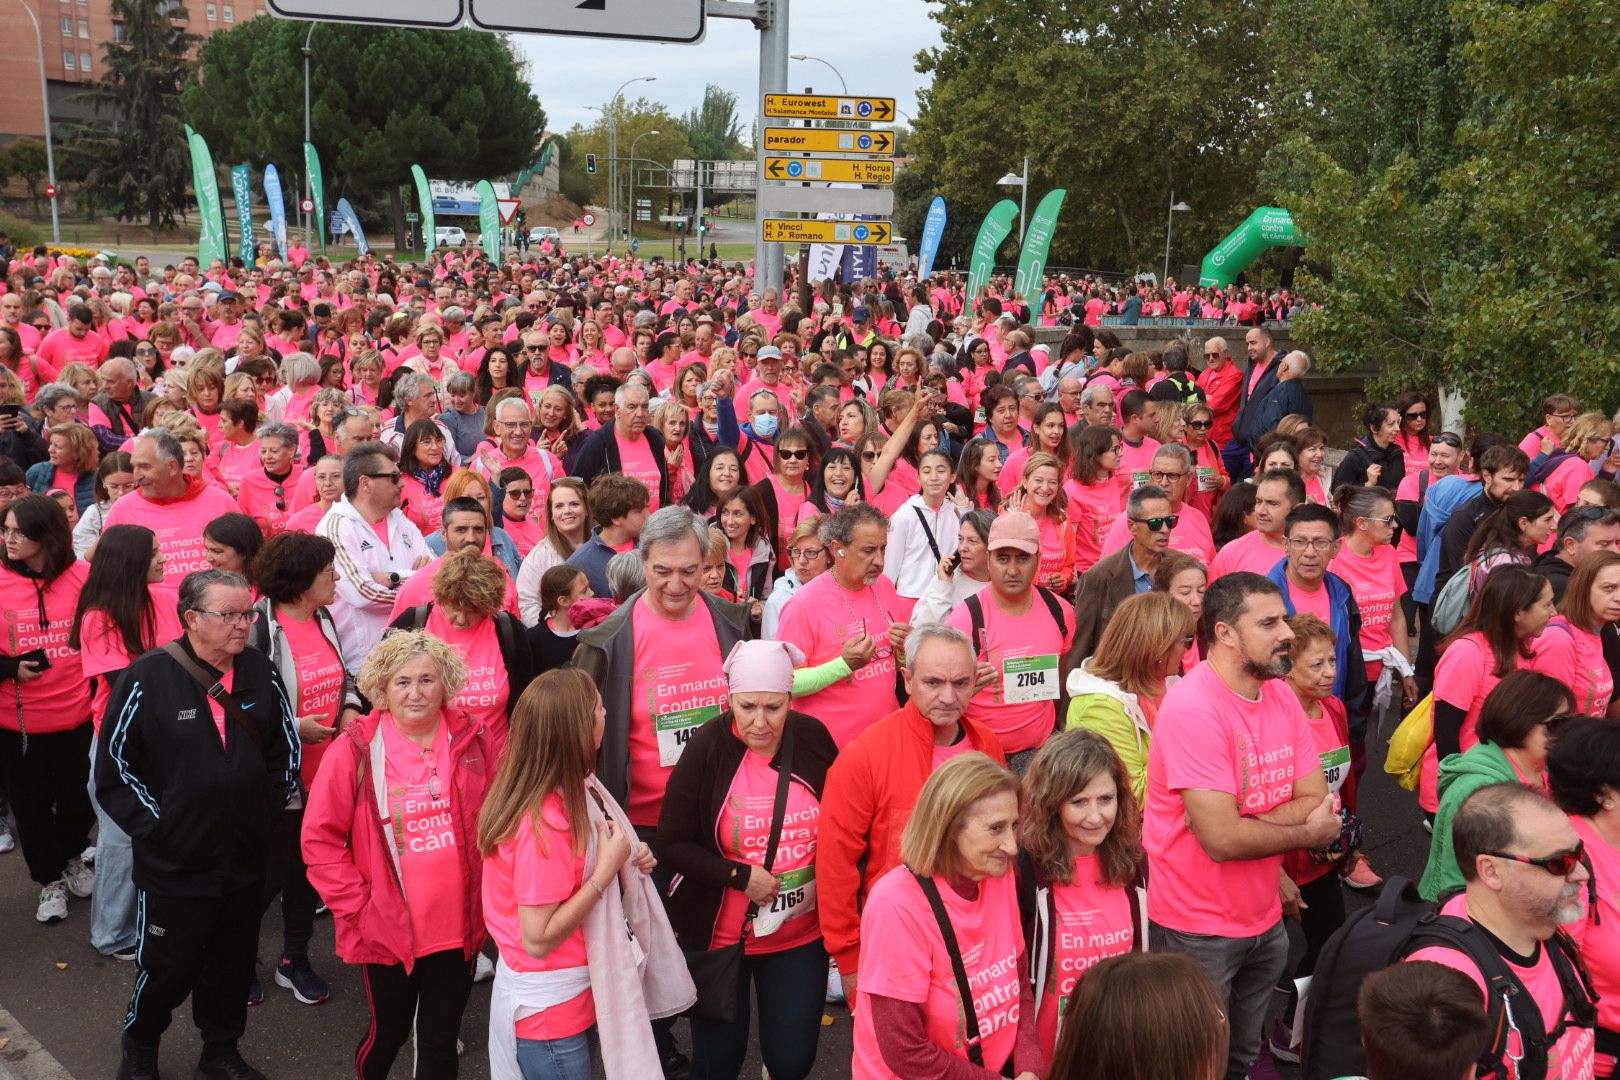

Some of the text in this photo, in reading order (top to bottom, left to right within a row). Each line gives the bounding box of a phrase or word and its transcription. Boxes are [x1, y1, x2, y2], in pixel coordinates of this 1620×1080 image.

[767, 98, 826, 108] H. Eurowest
[767, 135, 806, 145] parador
[852, 163, 891, 172] H. Horus
[854, 172, 891, 182] H. Regio
[778, 223, 803, 231] Vincci
[1261, 224, 1284, 232] contra
[765, 231, 824, 240] H. P. Romano
[163, 548, 200, 561] ontra
[1361, 612, 1393, 628] ánce
[17, 622, 35, 633] En
[19, 631, 71, 647] contra
[302, 670, 317, 682] En
[468, 666, 495, 678] rcha
[1017, 671, 1045, 687] 2764
[303, 676, 342, 697] contra
[657, 682, 677, 697] En
[455, 692, 498, 707] ncer
[658, 695, 715, 715] contra
[177, 708, 197, 721] NIKE
[405, 800, 428, 814] En
[744, 805, 820, 830] En arch
[743, 825, 811, 847] cotra
[770, 887, 805, 914] 2765
[1061, 933, 1084, 949] En
[974, 979, 1021, 1014] ontra
